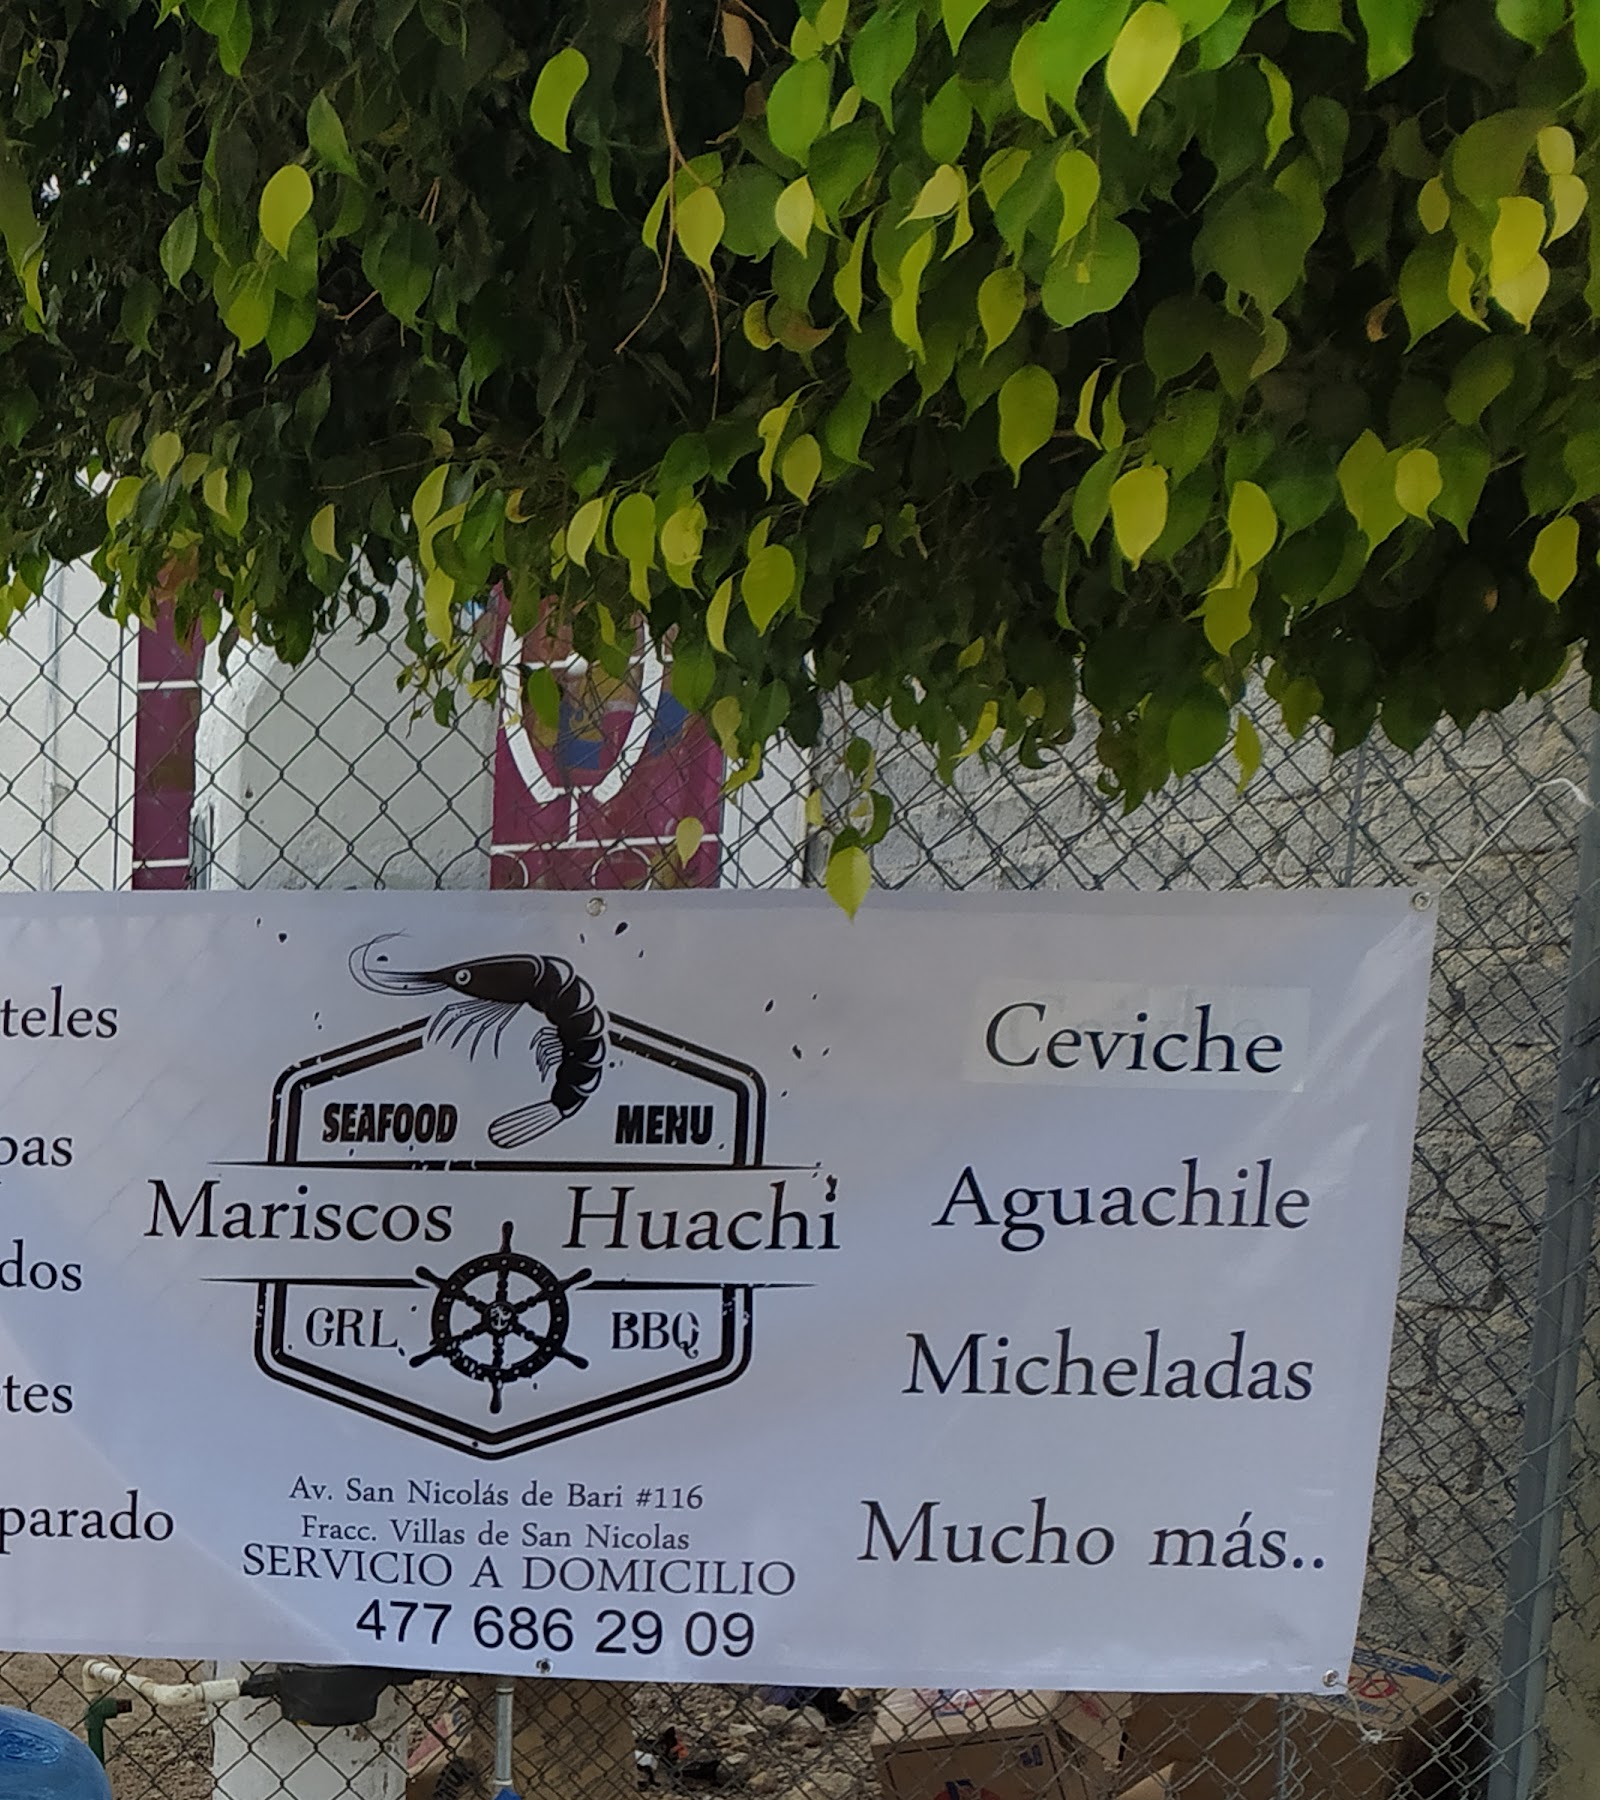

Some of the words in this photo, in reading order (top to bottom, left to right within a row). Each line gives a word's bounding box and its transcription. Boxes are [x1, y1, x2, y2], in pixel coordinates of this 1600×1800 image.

[985, 1002, 1283, 1074] Ceviche
[322, 1103, 458, 1144] SEAFOOD
[615, 1105, 713, 1145] MENU
[143, 1178, 453, 1242] Mariscos
[561, 1174, 841, 1251] Huachi
[931, 1157, 1311, 1252] Aguachile
[610, 1311, 700, 1357] BBQ
[902, 1327, 1314, 1401] Micheladas
[289, 1476, 333, 1501] Av.
[346, 1478, 394, 1503] San
[408, 1478, 509, 1506] Nicolás
[521, 1483, 553, 1508] de
[568, 1484, 623, 1509] Bari
[636, 1485, 703, 1510] #116
[301, 1515, 377, 1542] Fracc.
[390, 1518, 465, 1546] Villas
[478, 1521, 509, 1547] de
[522, 1524, 571, 1549] San
[585, 1522, 690, 1550] Nicolas
[856, 1496, 1115, 1564] Mucho
[1149, 1511, 1326, 1569] más..
[242, 1542, 453, 1587] SERVICIO
[469, 1555, 503, 1589] A
[522, 1556, 796, 1596] DOMICILIO
[356, 1600, 453, 1644] 477
[473, 1607, 575, 1652] 686
[595, 1609, 664, 1655] 29
[684, 1611, 755, 1658] 09
